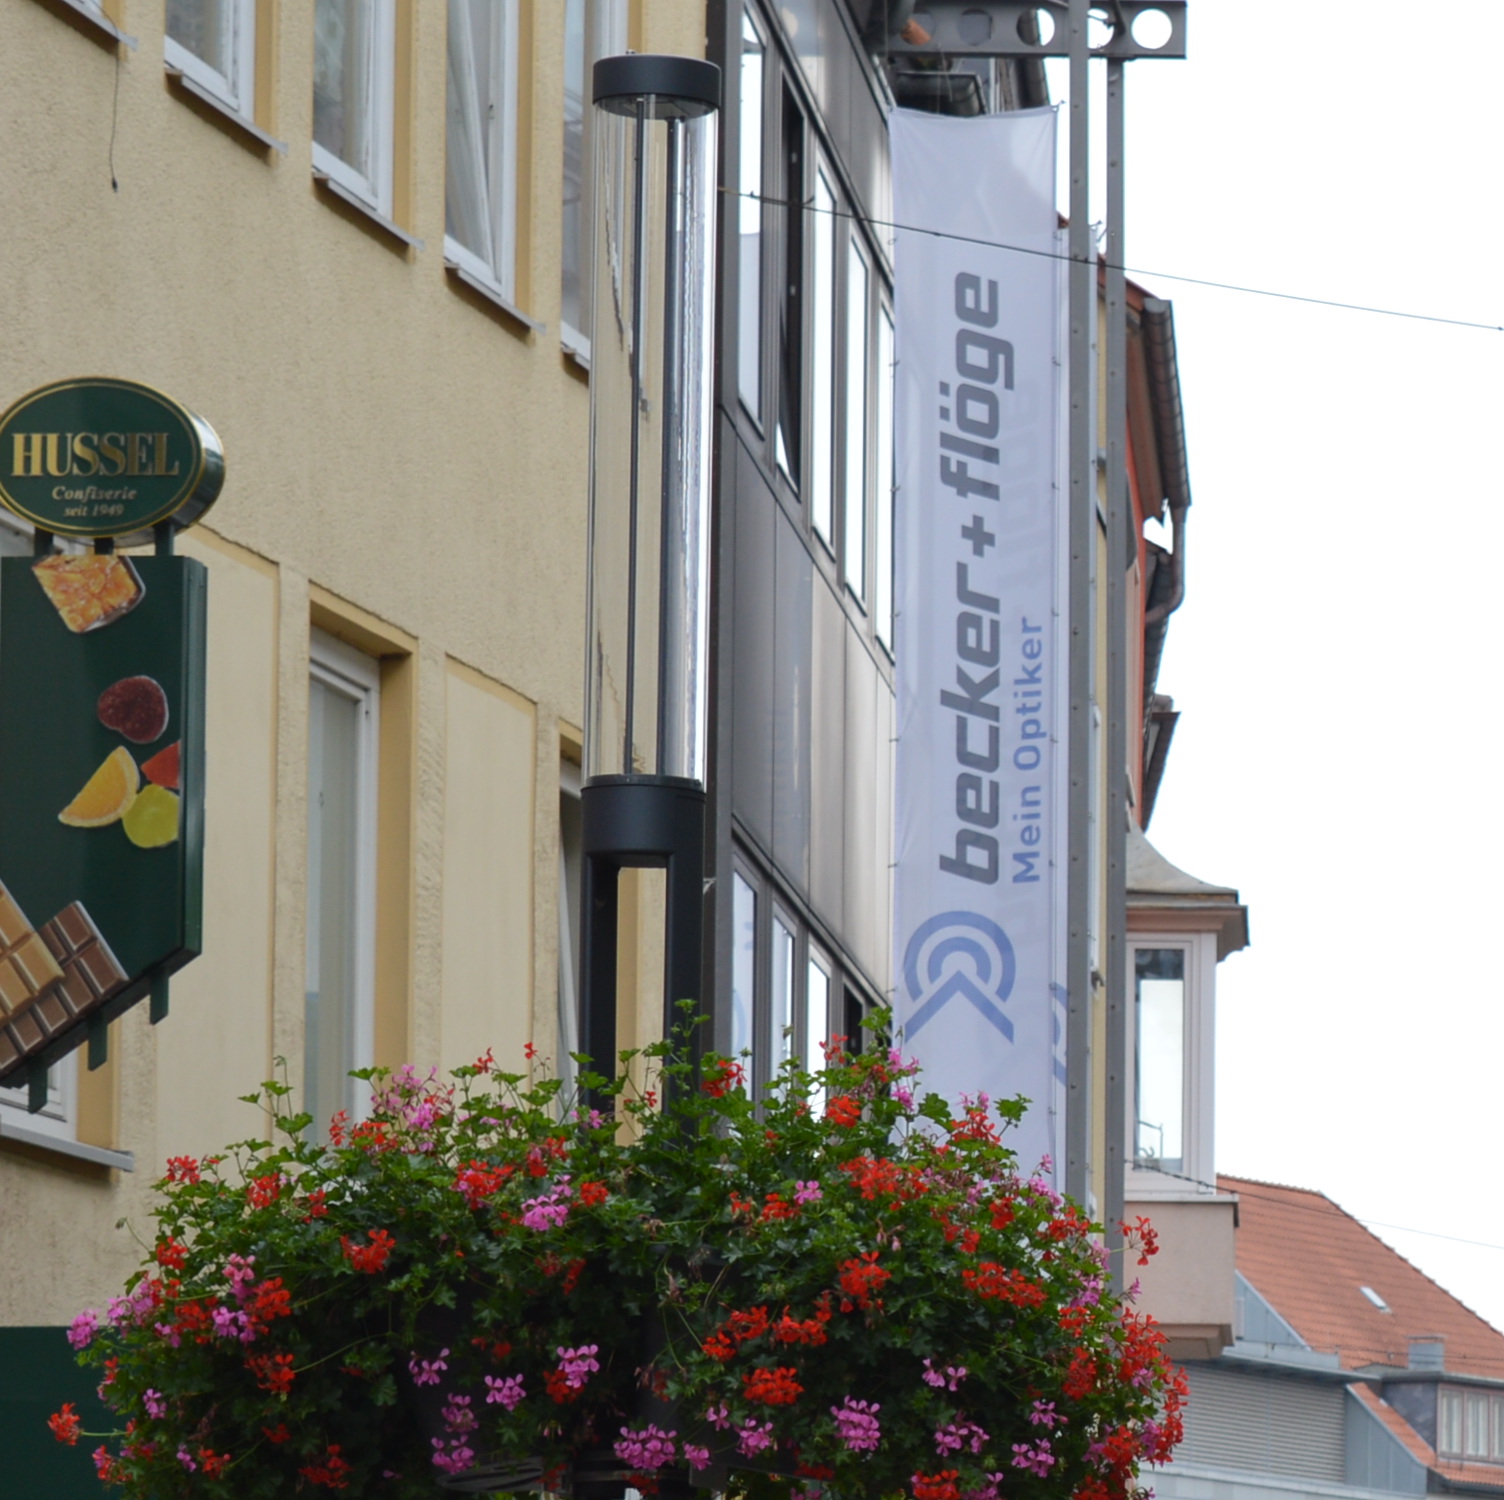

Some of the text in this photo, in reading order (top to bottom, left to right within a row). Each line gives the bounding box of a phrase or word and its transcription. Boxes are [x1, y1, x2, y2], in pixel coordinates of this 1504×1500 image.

[11, 431, 180, 477] HUSSEL
[938, 271, 1015, 502] flöge
[51, 485, 137, 503] Confiserie
[63, 504, 125, 517] seit 1949
[938, 559, 1000, 887] becker
[1012, 615, 1048, 885] Mein Optiker
